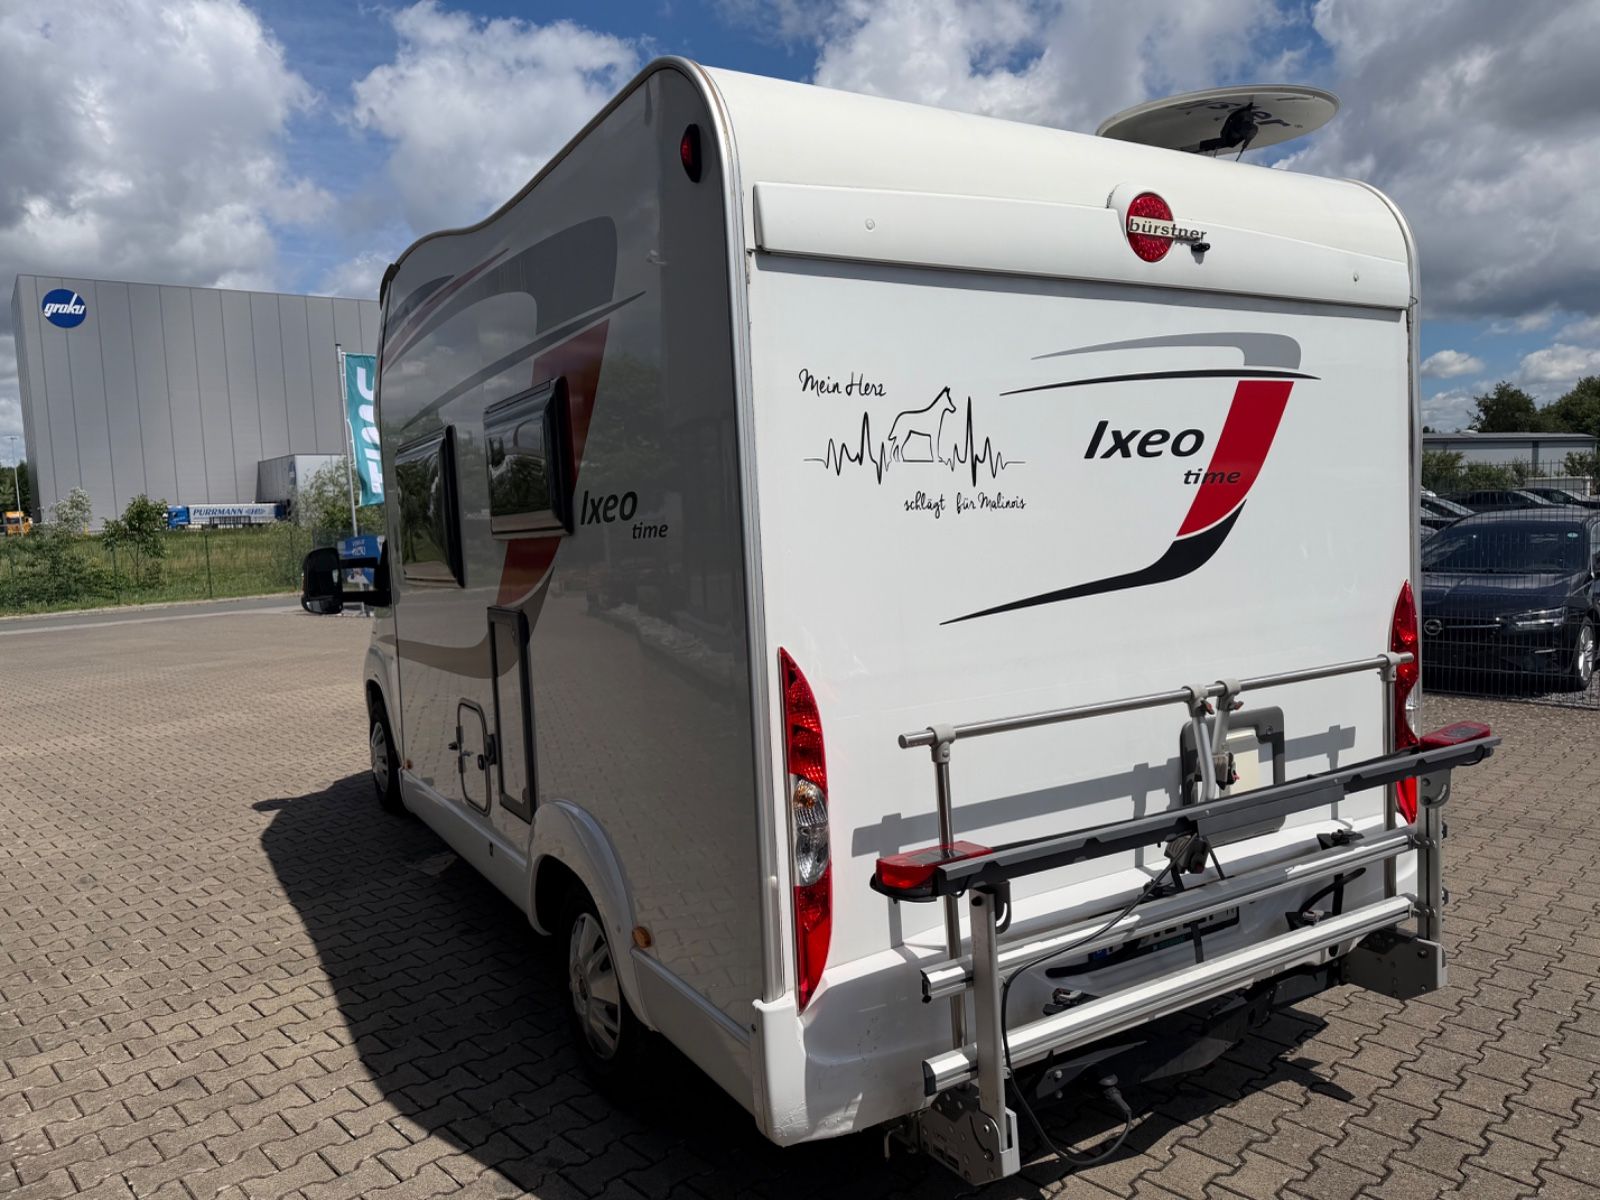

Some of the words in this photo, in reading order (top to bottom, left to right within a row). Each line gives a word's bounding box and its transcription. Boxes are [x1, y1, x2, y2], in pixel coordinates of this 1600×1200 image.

[1129, 218, 1207, 240] bürstner
[44, 292, 86, 318] groku
[798, 368, 842, 397] Mein
[845, 371, 887, 396] Herz
[1083, 420, 1205, 459] Ixeo
[1183, 468, 1241, 485] time
[193, 507, 243, 516] PURRMANN
[580, 490, 638, 525] Ixeo
[904, 490, 946, 519] schlägt
[956, 491, 977, 514] für
[977, 491, 1027, 511] Malinois
[632, 521, 669, 540] time
